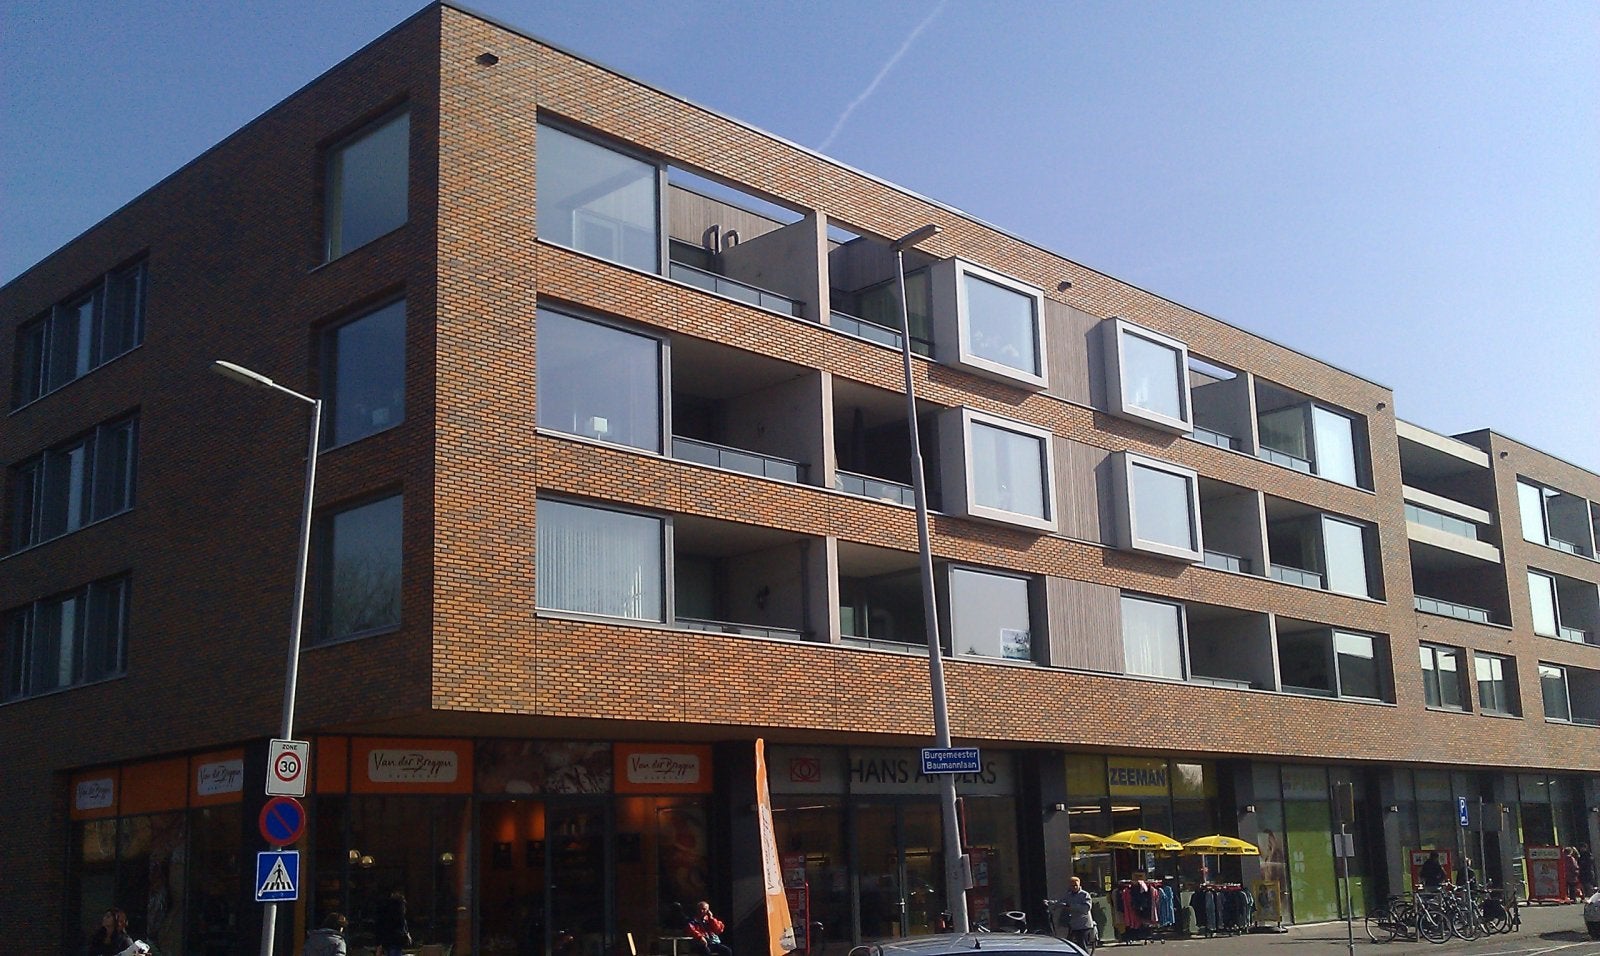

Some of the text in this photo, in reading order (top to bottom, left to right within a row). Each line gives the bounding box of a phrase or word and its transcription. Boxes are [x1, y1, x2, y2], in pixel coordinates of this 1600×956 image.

[374, 752, 395, 770] Van
[924, 751, 977, 761] Burgemeester
[280, 760, 297, 773] 30
[849, 758, 908, 783] HANS
[926, 761, 977, 770] Baumannlaan
[1109, 767, 1167, 787] ZEEMAN
